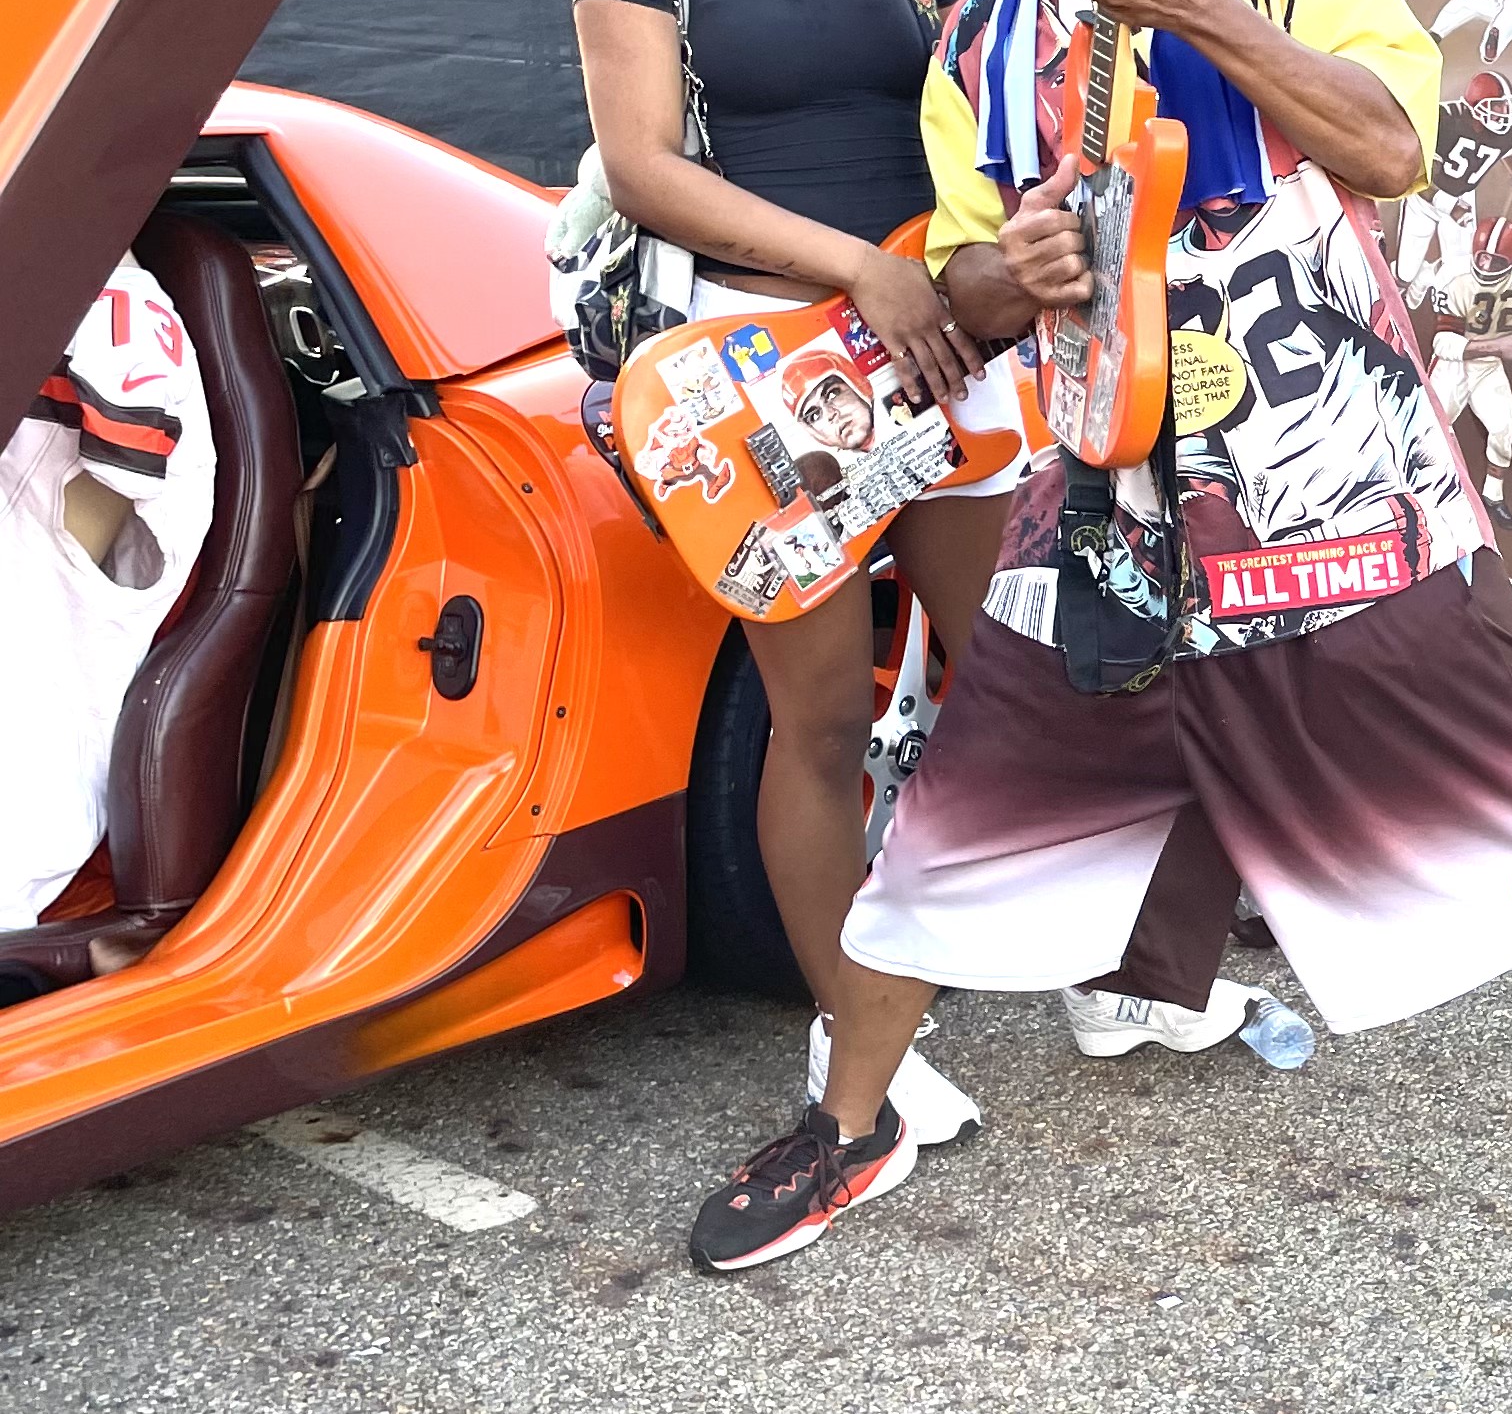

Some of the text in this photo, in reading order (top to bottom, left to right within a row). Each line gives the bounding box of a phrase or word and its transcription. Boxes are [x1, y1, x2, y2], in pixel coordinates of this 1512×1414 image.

[1443, 137, 1501, 184] 57
[1172, 343, 1193, 356] ESS
[1175, 355, 1208, 368] FINAL
[1172, 364, 1234, 382] NOT FATAL
[1174, 376, 1231, 395] COURAGE
[1173, 389, 1231, 408] INUE THAT
[881, 430, 909, 449] Graham
[1217, 540, 1394, 572] THE GREATEST RUNNING BACK OF
[1221, 552, 1400, 610] ALL TIME!
